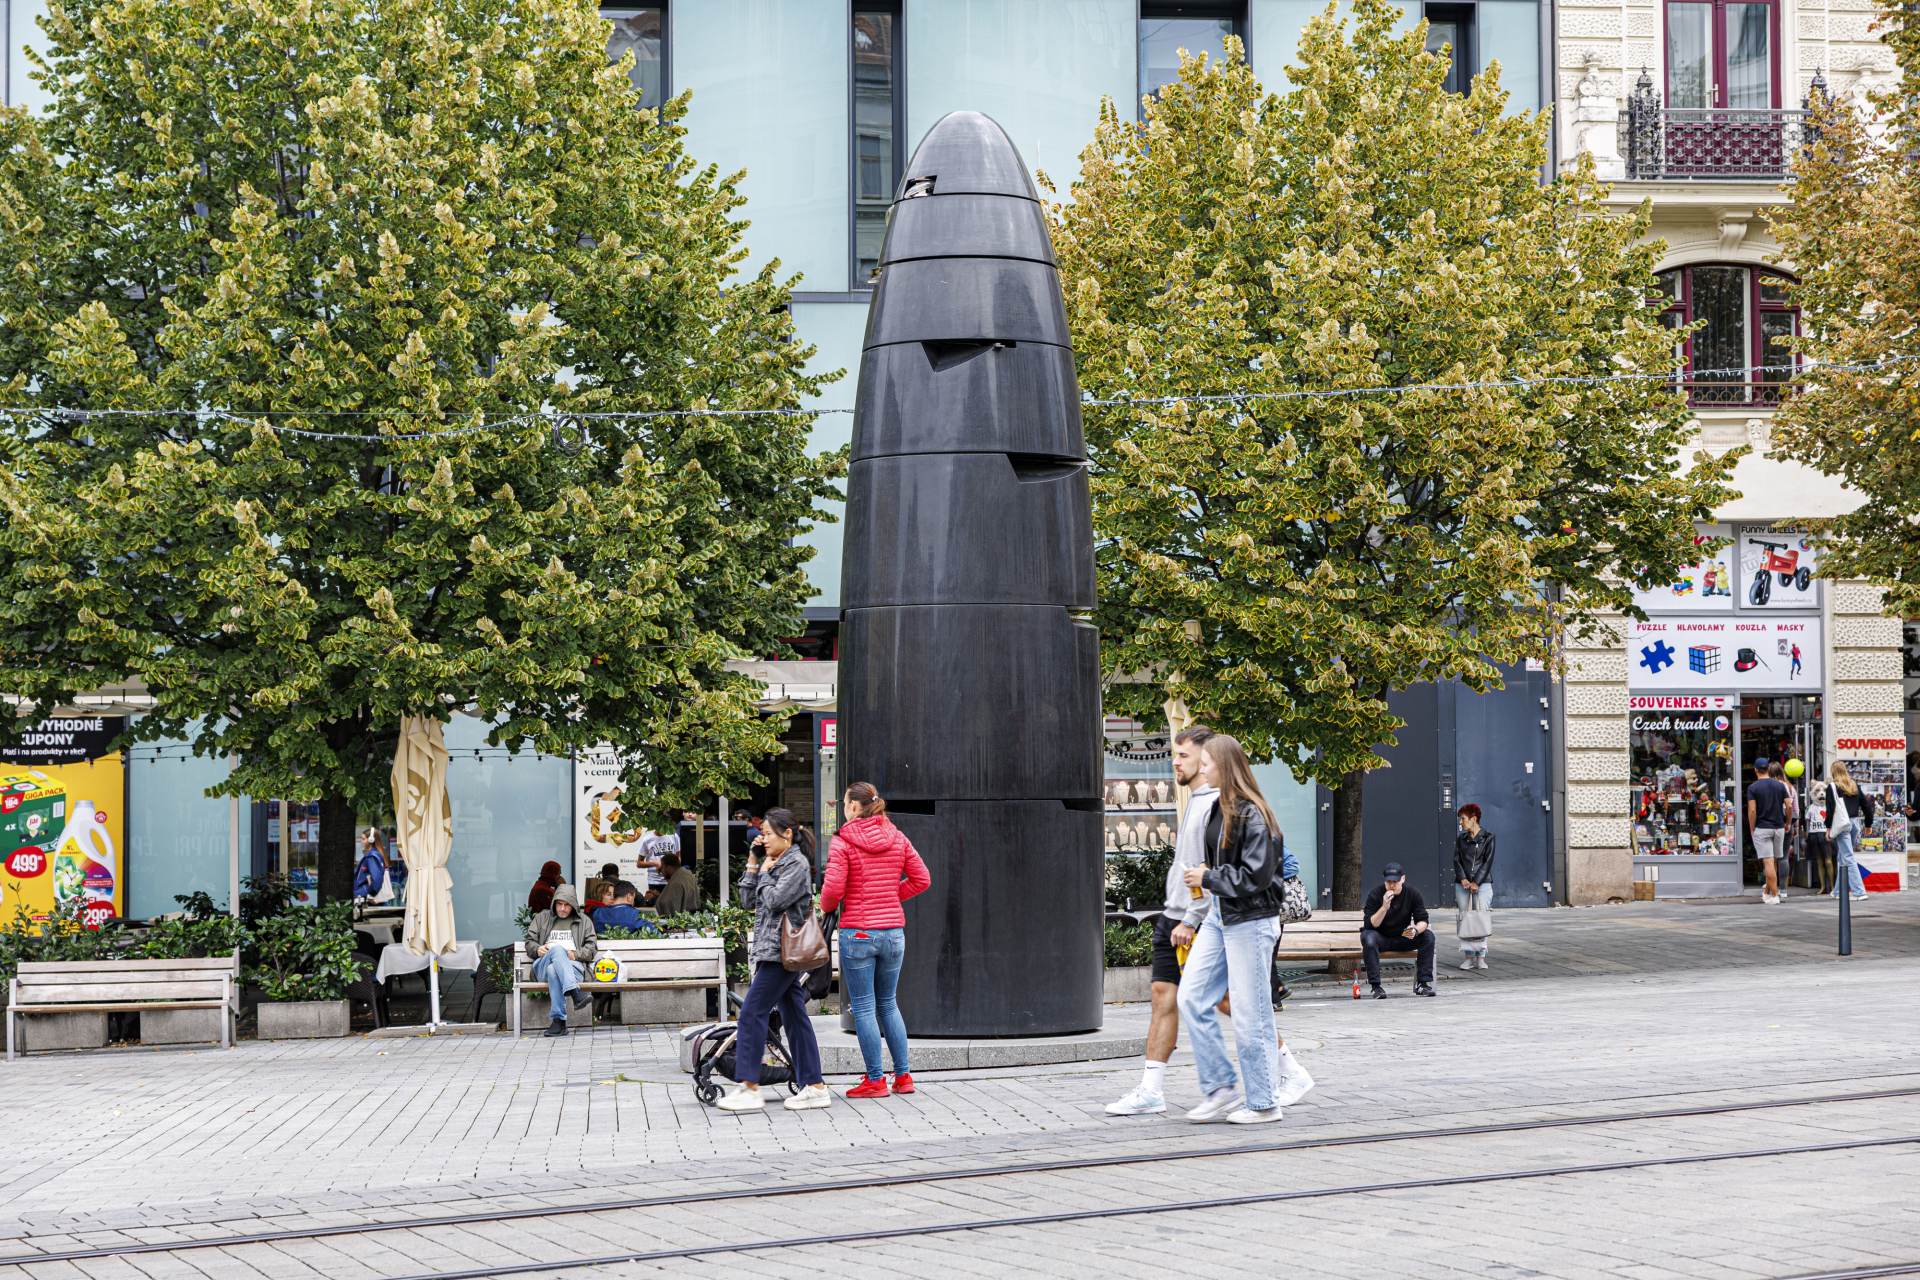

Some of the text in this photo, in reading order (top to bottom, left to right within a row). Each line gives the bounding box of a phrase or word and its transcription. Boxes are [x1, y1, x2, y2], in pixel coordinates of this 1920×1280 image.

[1630, 697, 1707, 708] SOUVENIRS
[1632, 716, 1710, 730] Czech trade
[1837, 739, 1905, 749] SOUVENIRS
